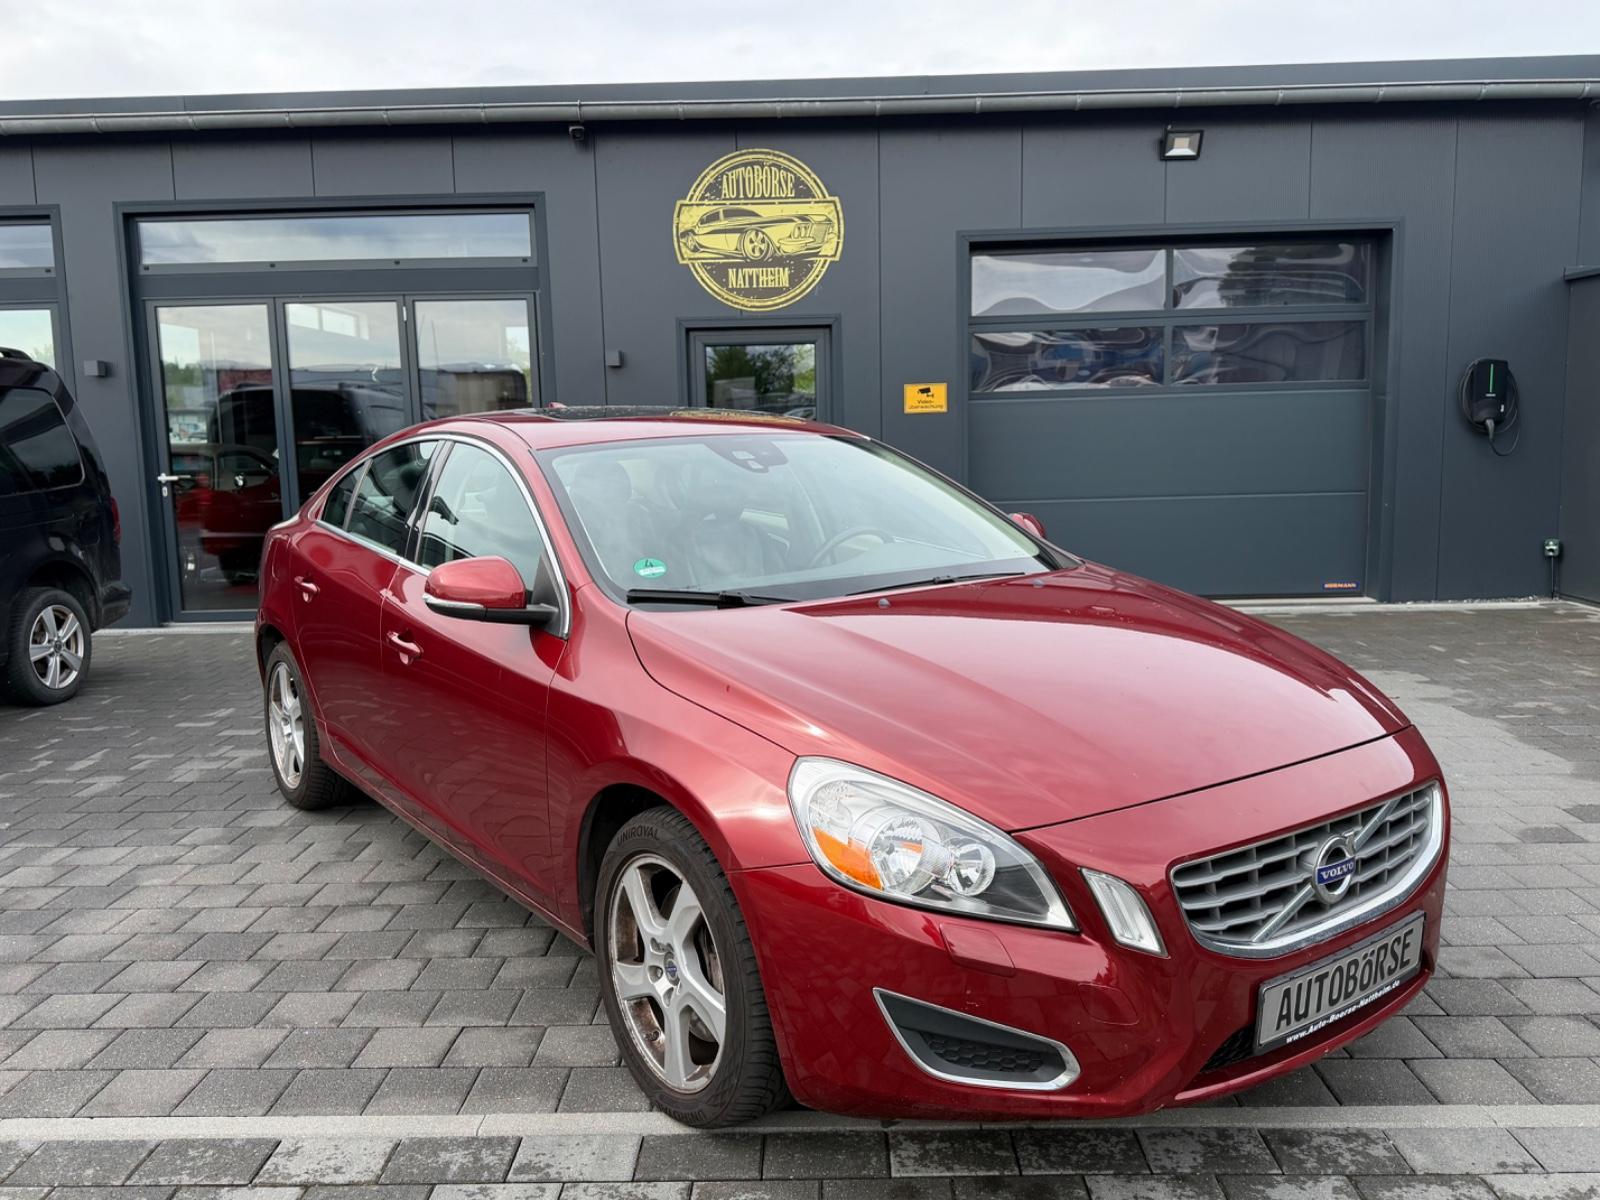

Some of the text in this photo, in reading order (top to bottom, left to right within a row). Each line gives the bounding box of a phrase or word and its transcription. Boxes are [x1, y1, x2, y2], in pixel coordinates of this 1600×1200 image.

[721, 162, 795, 198] AUTOBÖRSE
[728, 267, 790, 289] NATTHEIM
[617, 825, 660, 847] UNIROYAL
[1319, 861, 1355, 881] VOLVO
[1275, 928, 1414, 1031] AUTOBÖRSE
